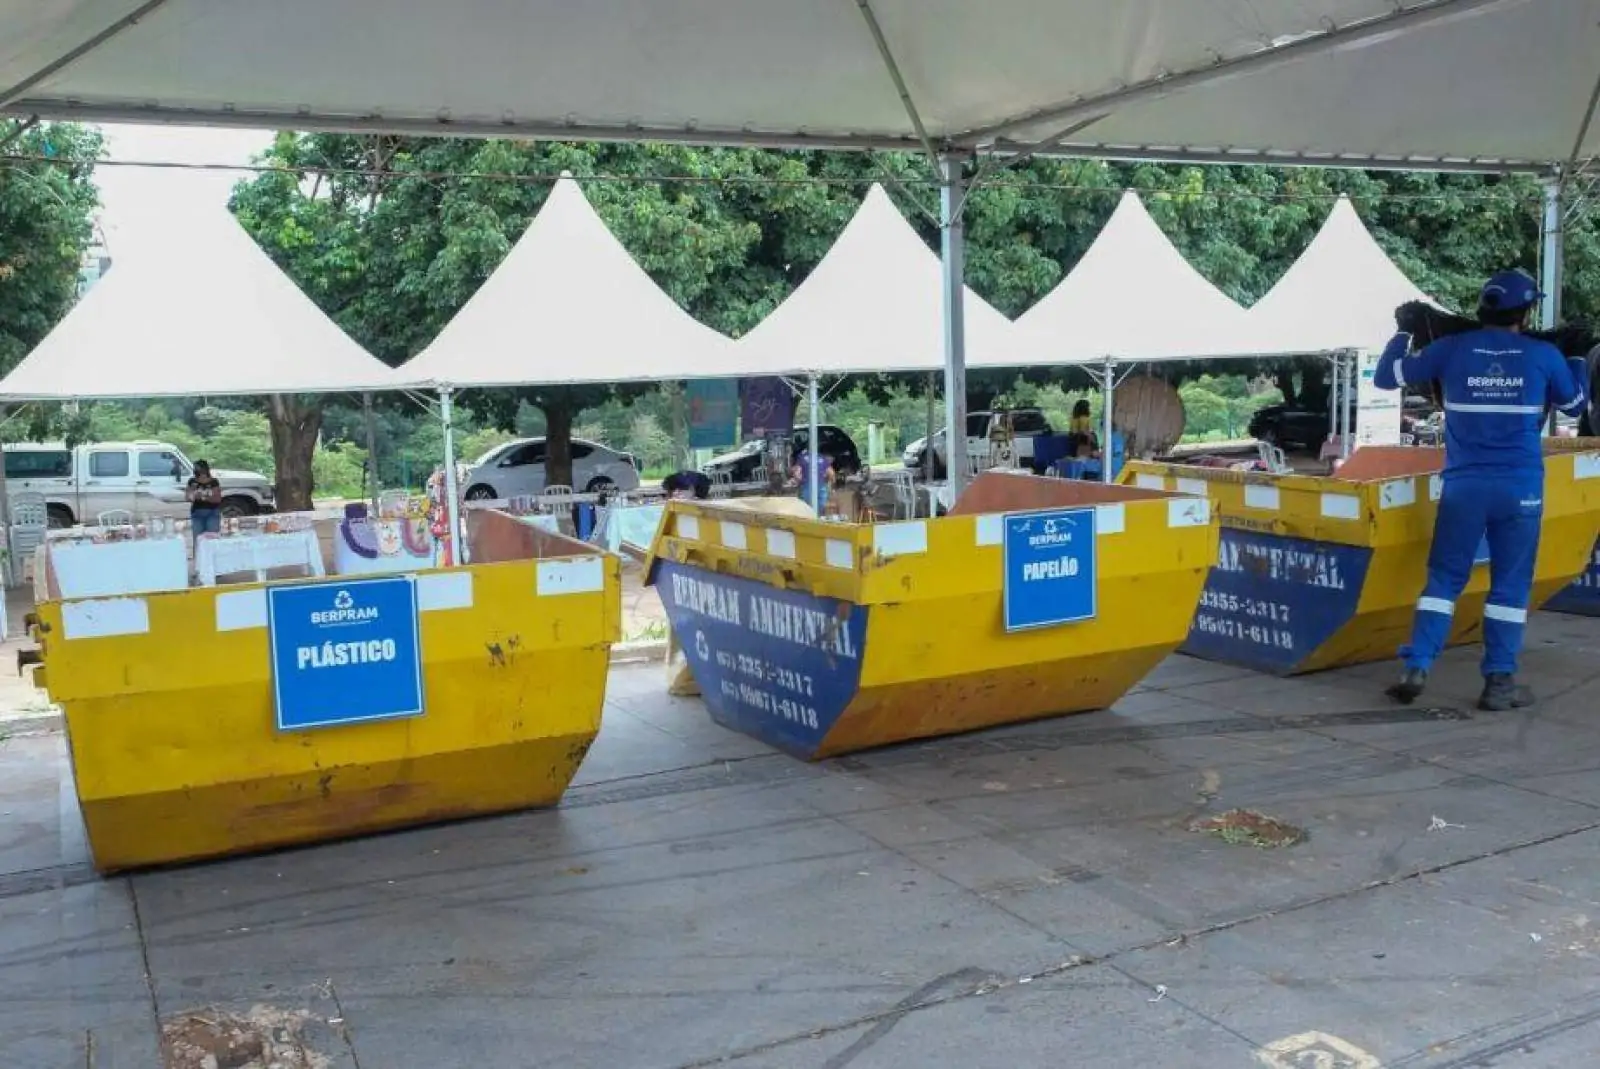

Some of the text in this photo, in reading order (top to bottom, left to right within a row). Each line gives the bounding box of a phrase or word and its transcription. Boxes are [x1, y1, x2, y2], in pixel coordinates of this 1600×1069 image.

[1467, 376, 1524, 387] BERPRAM
[1028, 532, 1072, 546] BERPRAM
[1023, 555, 1078, 582] PAPELÃO
[310, 606, 378, 624] BERPRAM
[296, 638, 396, 669] PLÁSTICO
